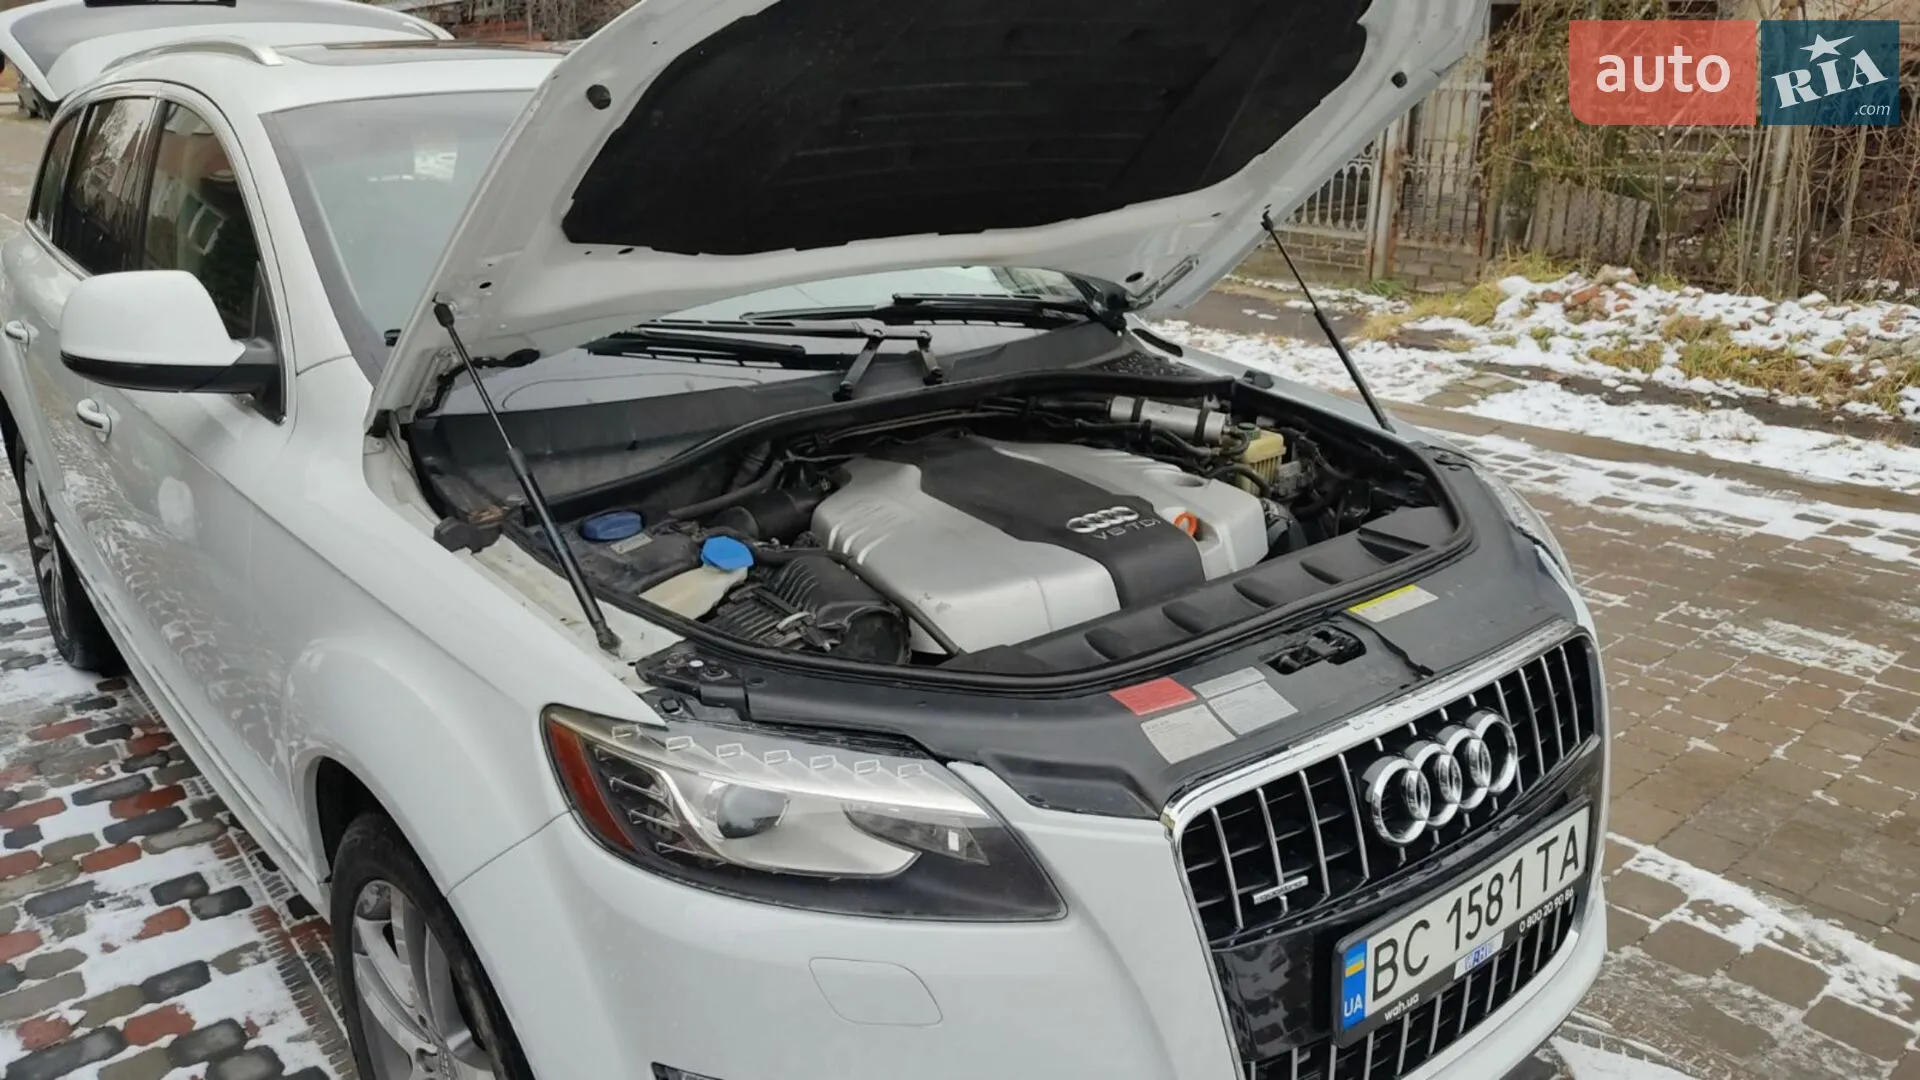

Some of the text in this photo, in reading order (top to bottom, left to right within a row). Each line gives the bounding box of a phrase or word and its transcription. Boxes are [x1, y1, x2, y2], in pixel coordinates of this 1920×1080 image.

[1373, 825, 1580, 1002] BC 1581 TA
[1344, 994, 1363, 1017] UA
